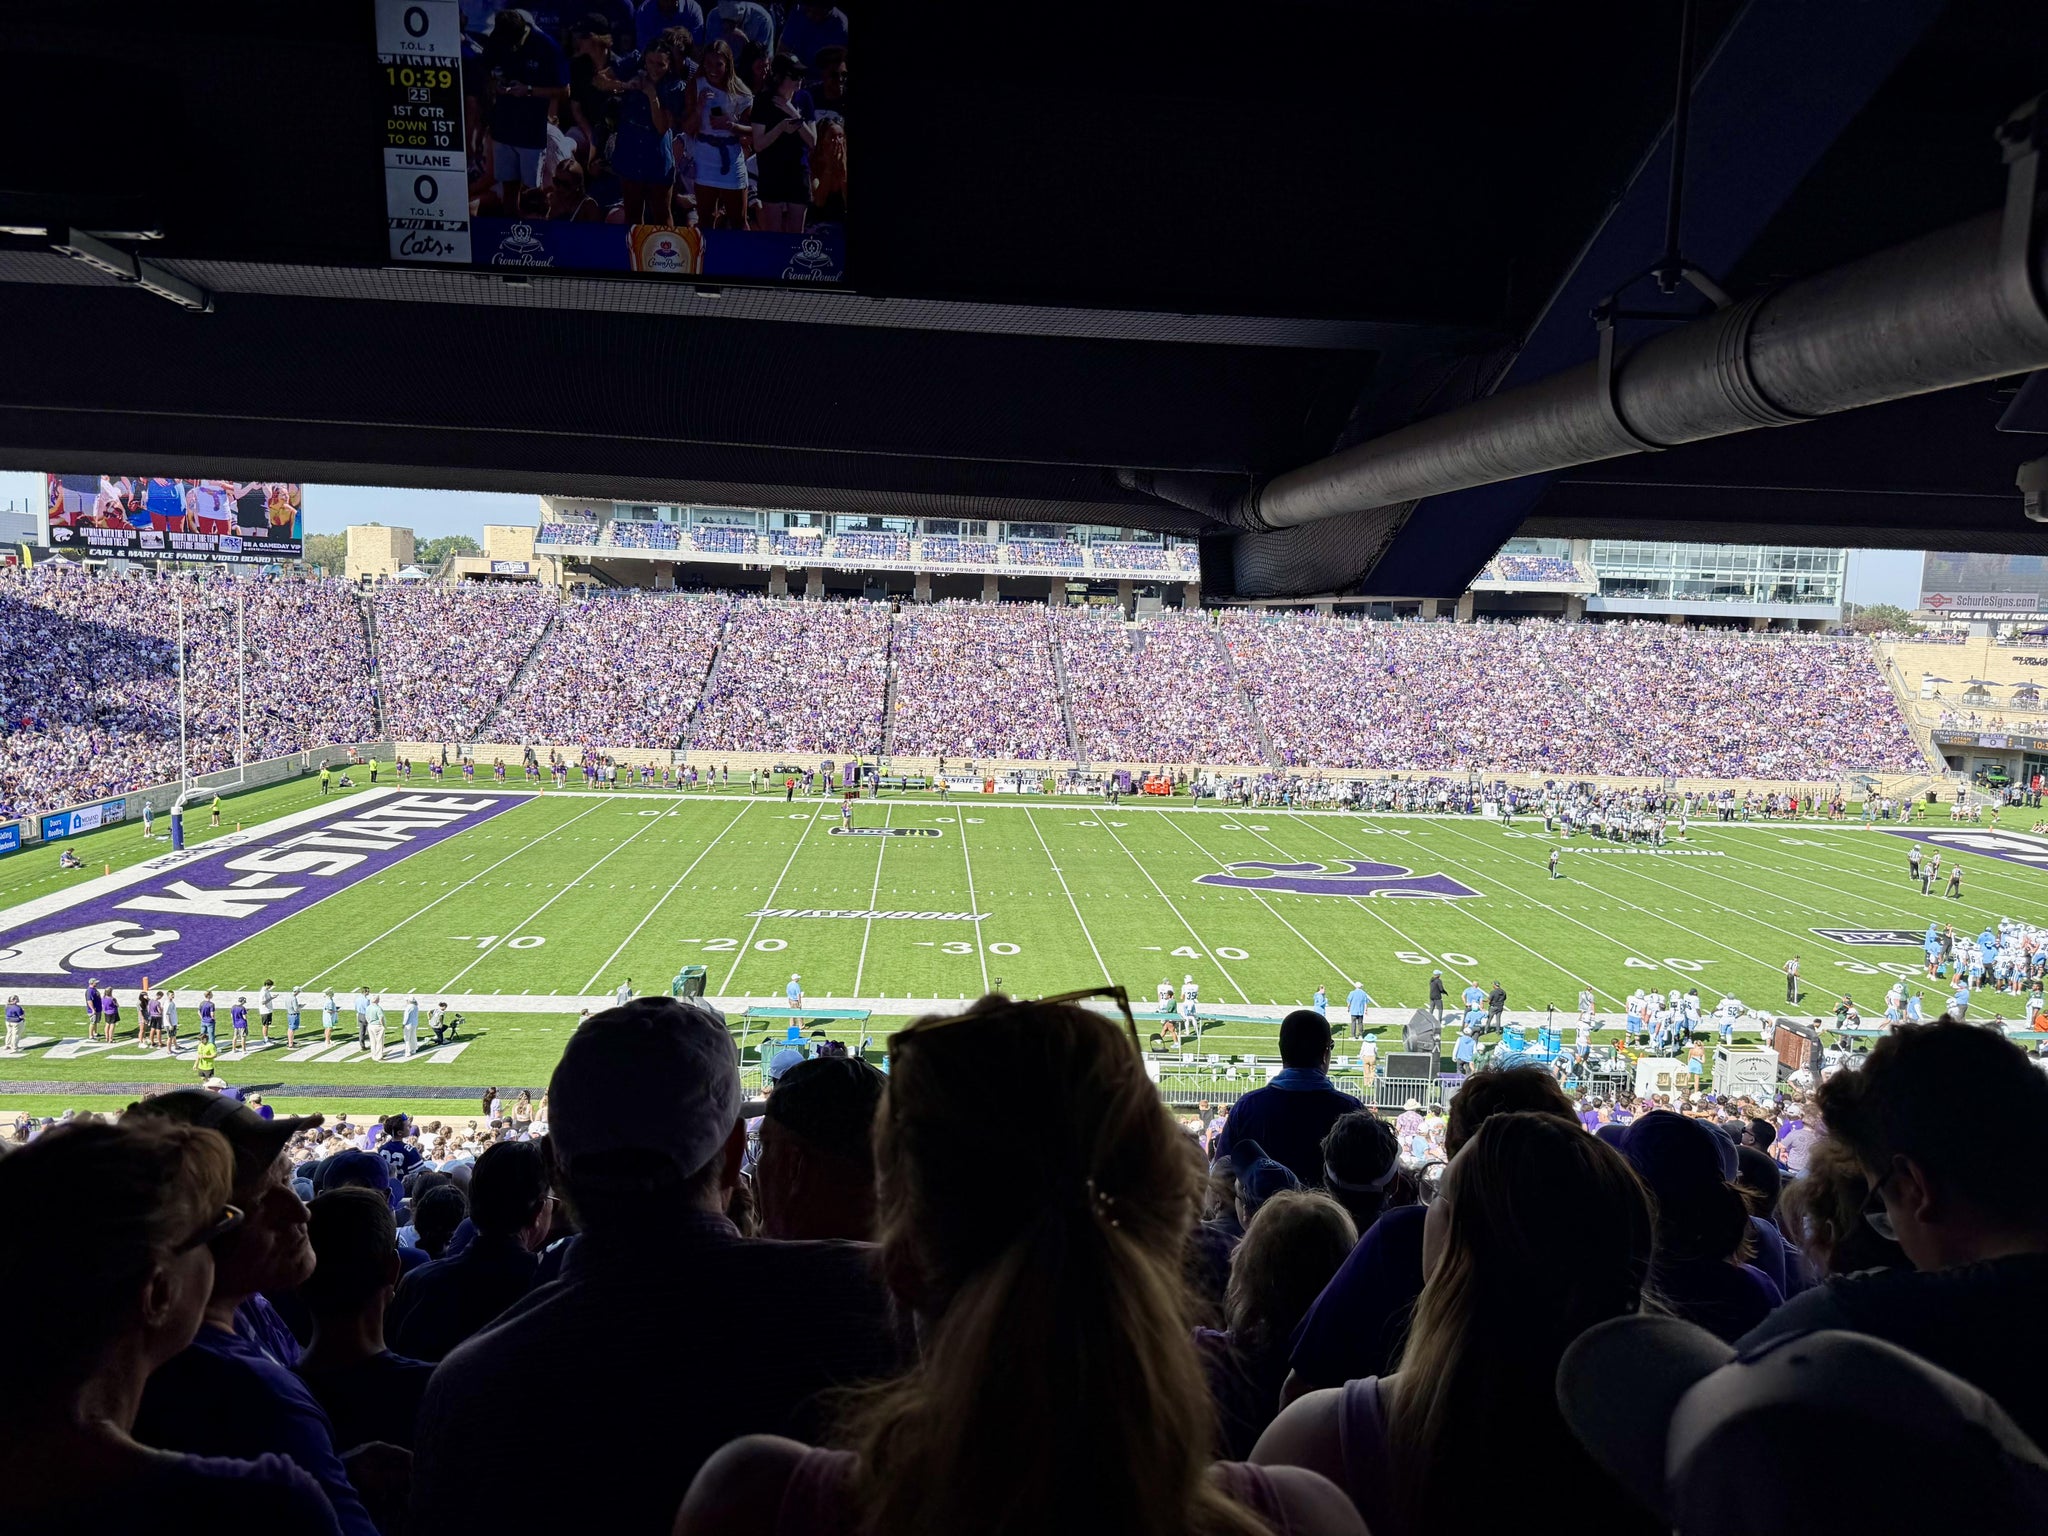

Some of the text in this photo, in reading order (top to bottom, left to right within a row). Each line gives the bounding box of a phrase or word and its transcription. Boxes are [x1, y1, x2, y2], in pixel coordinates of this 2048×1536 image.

[403, 6, 430, 38] 0
[400, 41, 435, 52] T.O.L. 3
[386, 67, 452, 89] 10:39
[410, 89, 428, 101] 25
[393, 105, 444, 118] 1ST QTR
[387, 119, 455, 133] DOWN 1ST
[388, 133, 450, 147] TO GO 10
[395, 154, 451, 167] TULANE
[413, 174, 439, 205] 0
[410, 207, 445, 217] T.O.L. 3
[491, 252, 554, 268] Crown Royal
[648, 256, 685, 269] Crown Royal
[781, 267, 844, 283] Crown Royal
[258, 542, 290, 550] GAMEDAY
[89, 548, 271, 563] CARL & MARY ICE FAMILY VIDEO BOARD
[1956, 595, 2036, 608] SchurleSigns.com
[1949, 611, 1972, 619] CARL
[1982, 612, 2010, 620] MARY
[50, 819, 62, 827] Doors
[48, 828, 64, 838] Roofing
[112, 794, 500, 919] K-STATE
[1560, 847, 1726, 857] PROGRESSIVE
[744, 908, 995, 921] PROGRESSIVE
[1629, 1002, 1638, 1012] 71
[1727, 1006, 1738, 1016] 52
